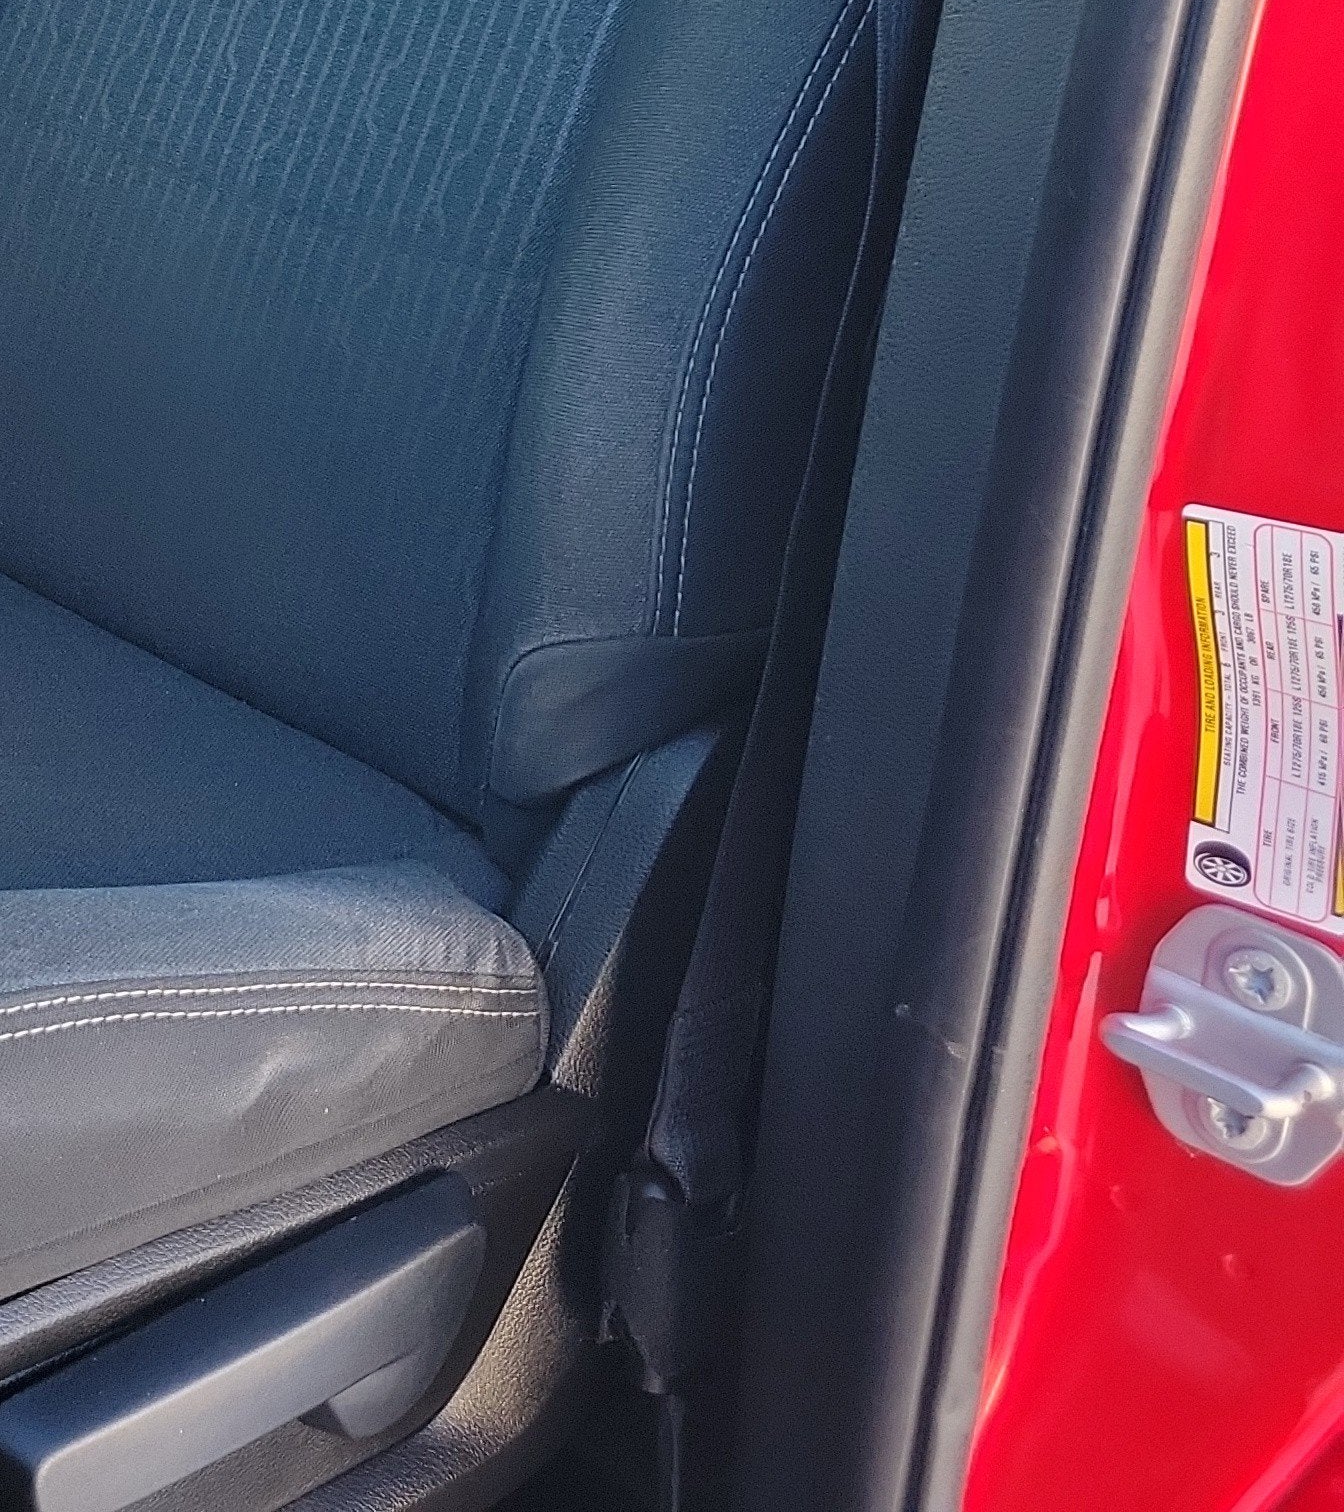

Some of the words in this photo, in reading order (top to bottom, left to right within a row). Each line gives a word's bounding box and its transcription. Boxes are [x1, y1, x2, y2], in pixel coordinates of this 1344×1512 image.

[1227, 526, 1236, 554] EXCEED
[1228, 557, 1237, 580] NEVER
[1229, 582, 1239, 610] SHOULD
[1261, 580, 1270, 603] SPARE
[1196, 597, 1211, 652] INFORMATION
[1232, 612, 1241, 635] CARGO
[1235, 637, 1244, 651] AND
[1266, 641, 1276, 660] REAR
[1203, 654, 1215, 690] LOADING
[1237, 653, 1248, 693] OCCUPANTS
[1249, 657, 1258, 666] OR
[1223, 674, 1231, 691] TOTAL
[1251, 675, 1260, 685] KG
[1205, 693, 1215, 711] AND
[1240, 696, 1248, 704] OF
[1205, 713, 1215, 733] TIRE
[1240, 707, 1249, 735] WEIGHT
[1271, 718, 1279, 743] FRONT
[1223, 737, 1231, 766] SEATING
[1238, 738, 1248, 777] COMBINED
[1236, 779, 1245, 794] THE
